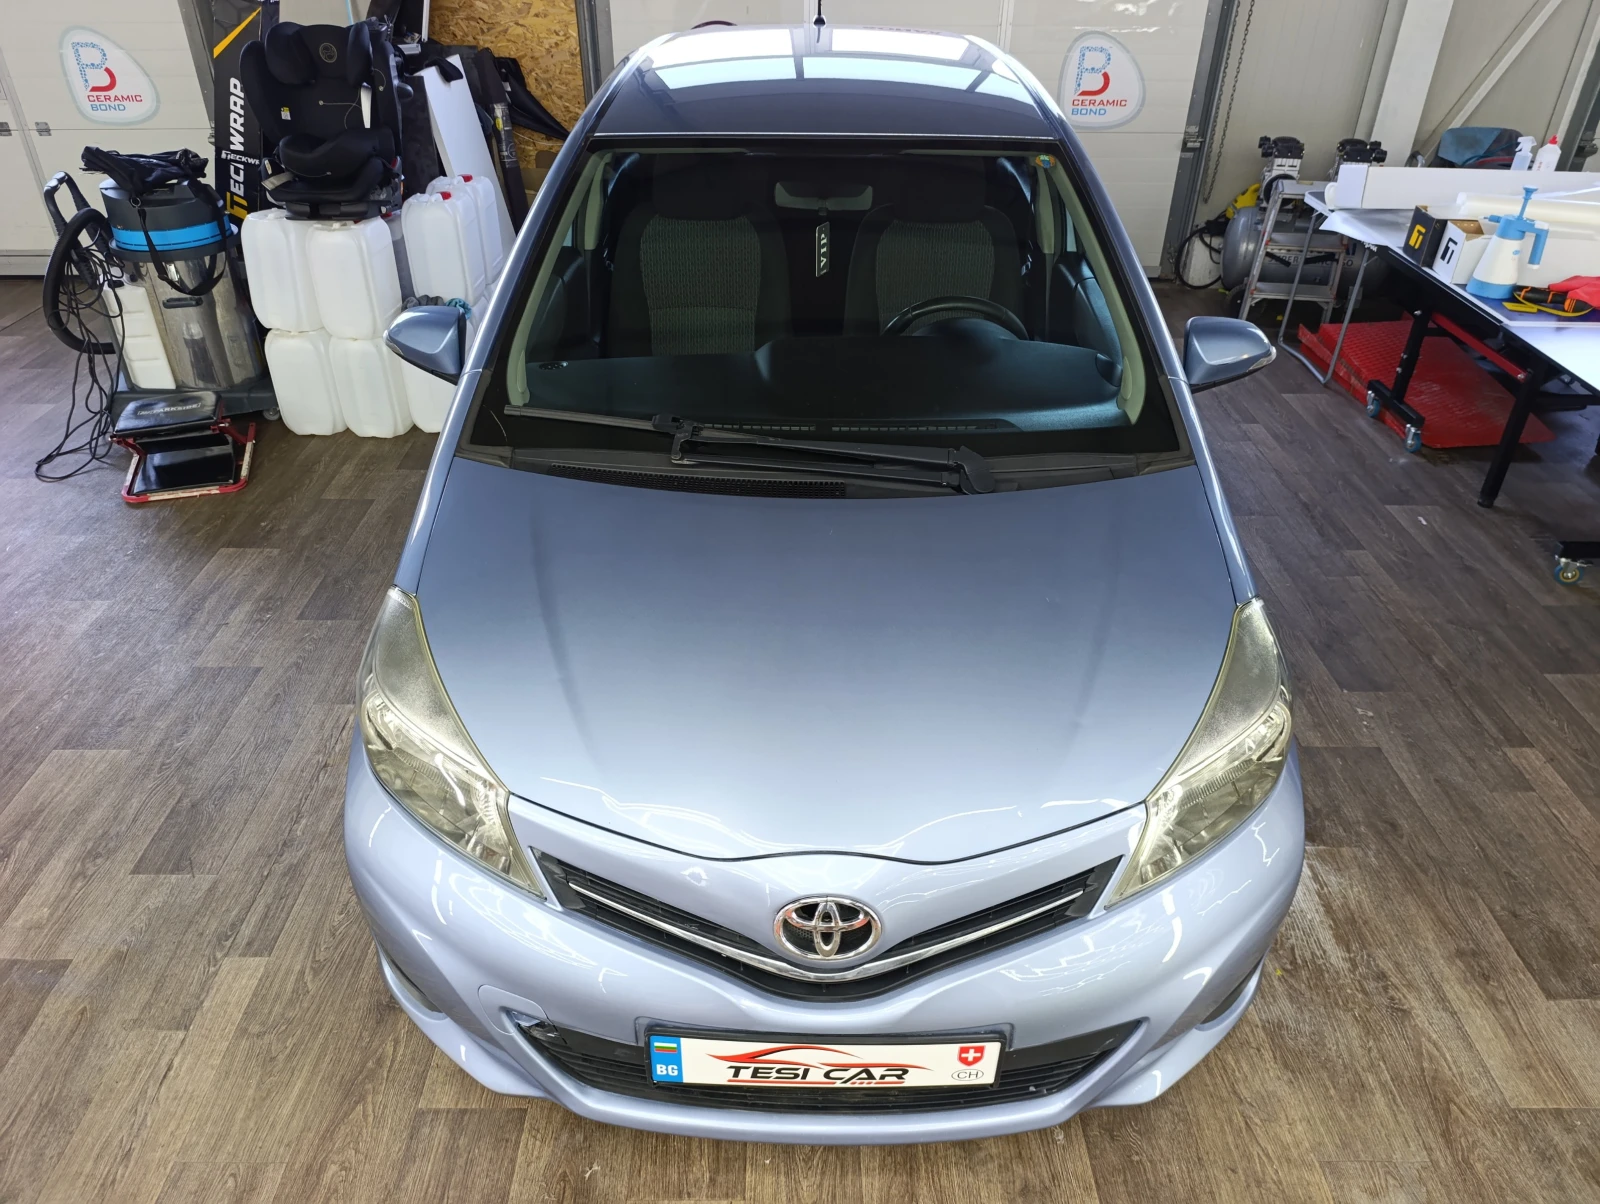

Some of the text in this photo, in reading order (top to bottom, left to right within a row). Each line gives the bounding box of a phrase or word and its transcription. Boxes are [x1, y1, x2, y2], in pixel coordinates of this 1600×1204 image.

[87, 94, 143, 102] CERAMIC
[90, 103, 126, 111] BOND
[1072, 99, 1128, 107] CERAMIC
[1071, 108, 1107, 116] BOND
[656, 1064, 679, 1076] BG
[727, 1065, 909, 1084] TESI CAR
[957, 1070, 980, 1079] CH
